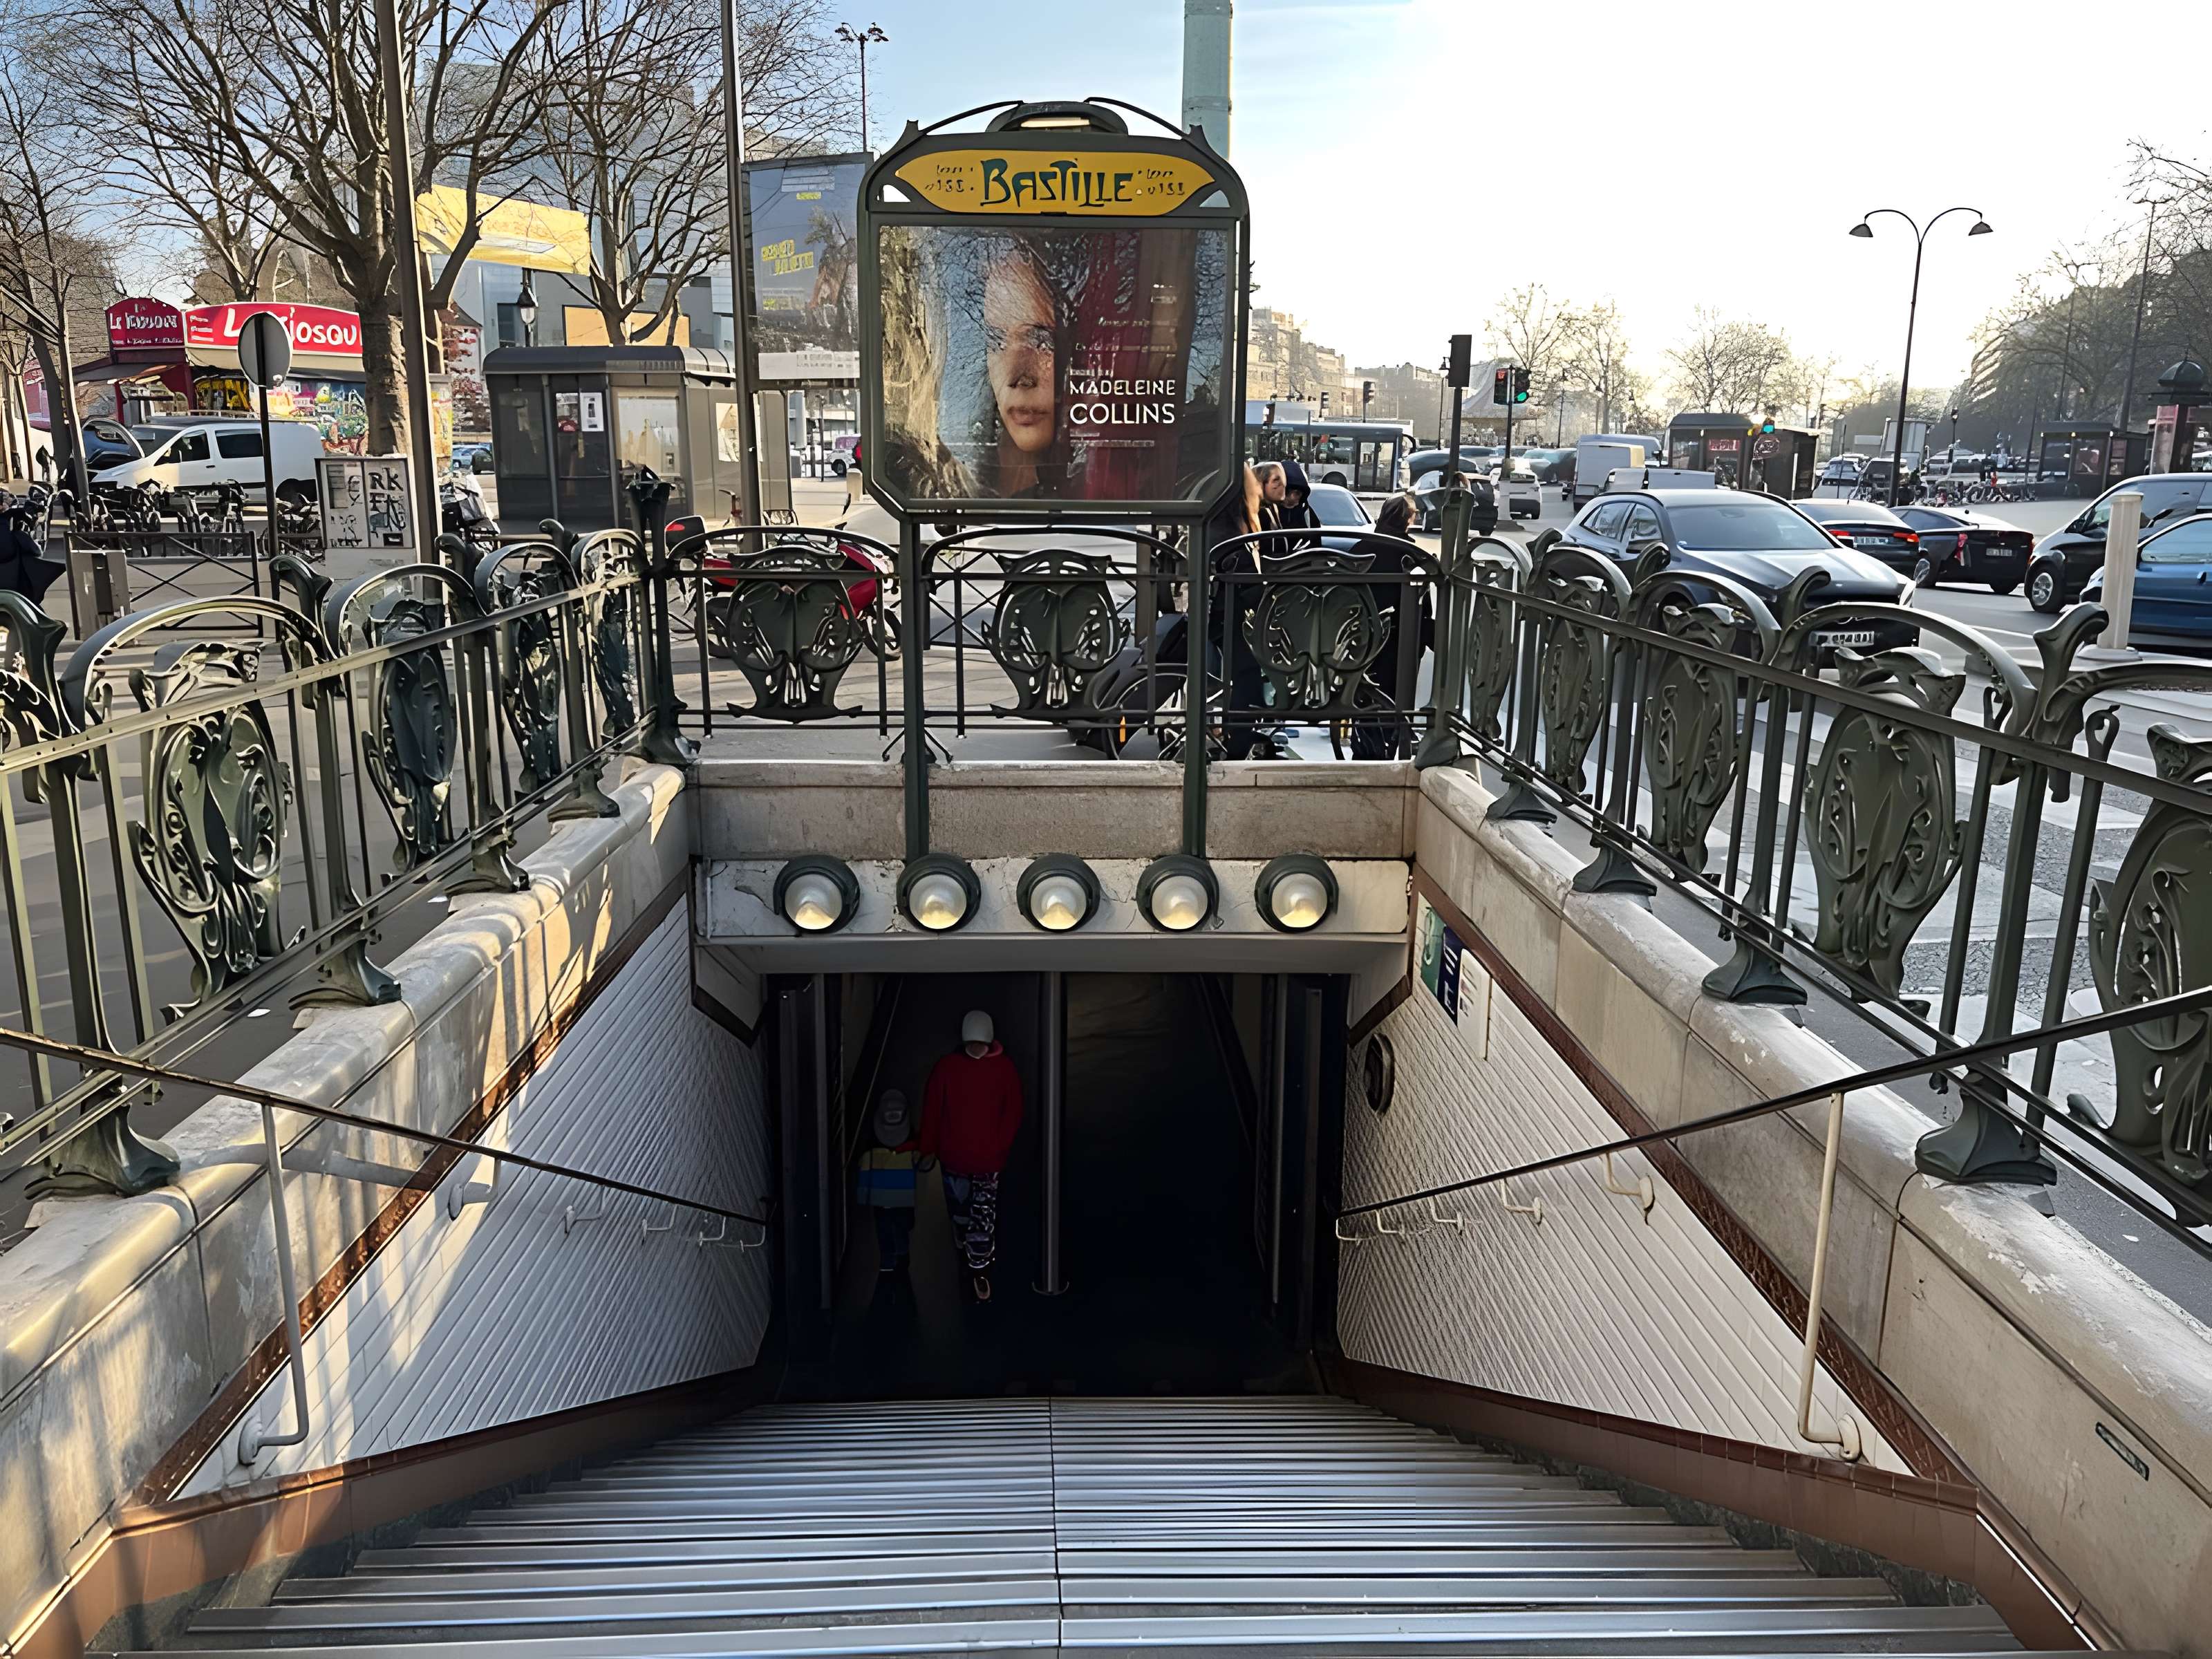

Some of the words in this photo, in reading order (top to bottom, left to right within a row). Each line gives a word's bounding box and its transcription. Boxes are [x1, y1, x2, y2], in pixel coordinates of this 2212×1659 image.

[980, 158, 1134, 207] BASTILLE
[1069, 379, 1176, 395] MADELEINE
[1069, 403, 1176, 424] COLLINS
